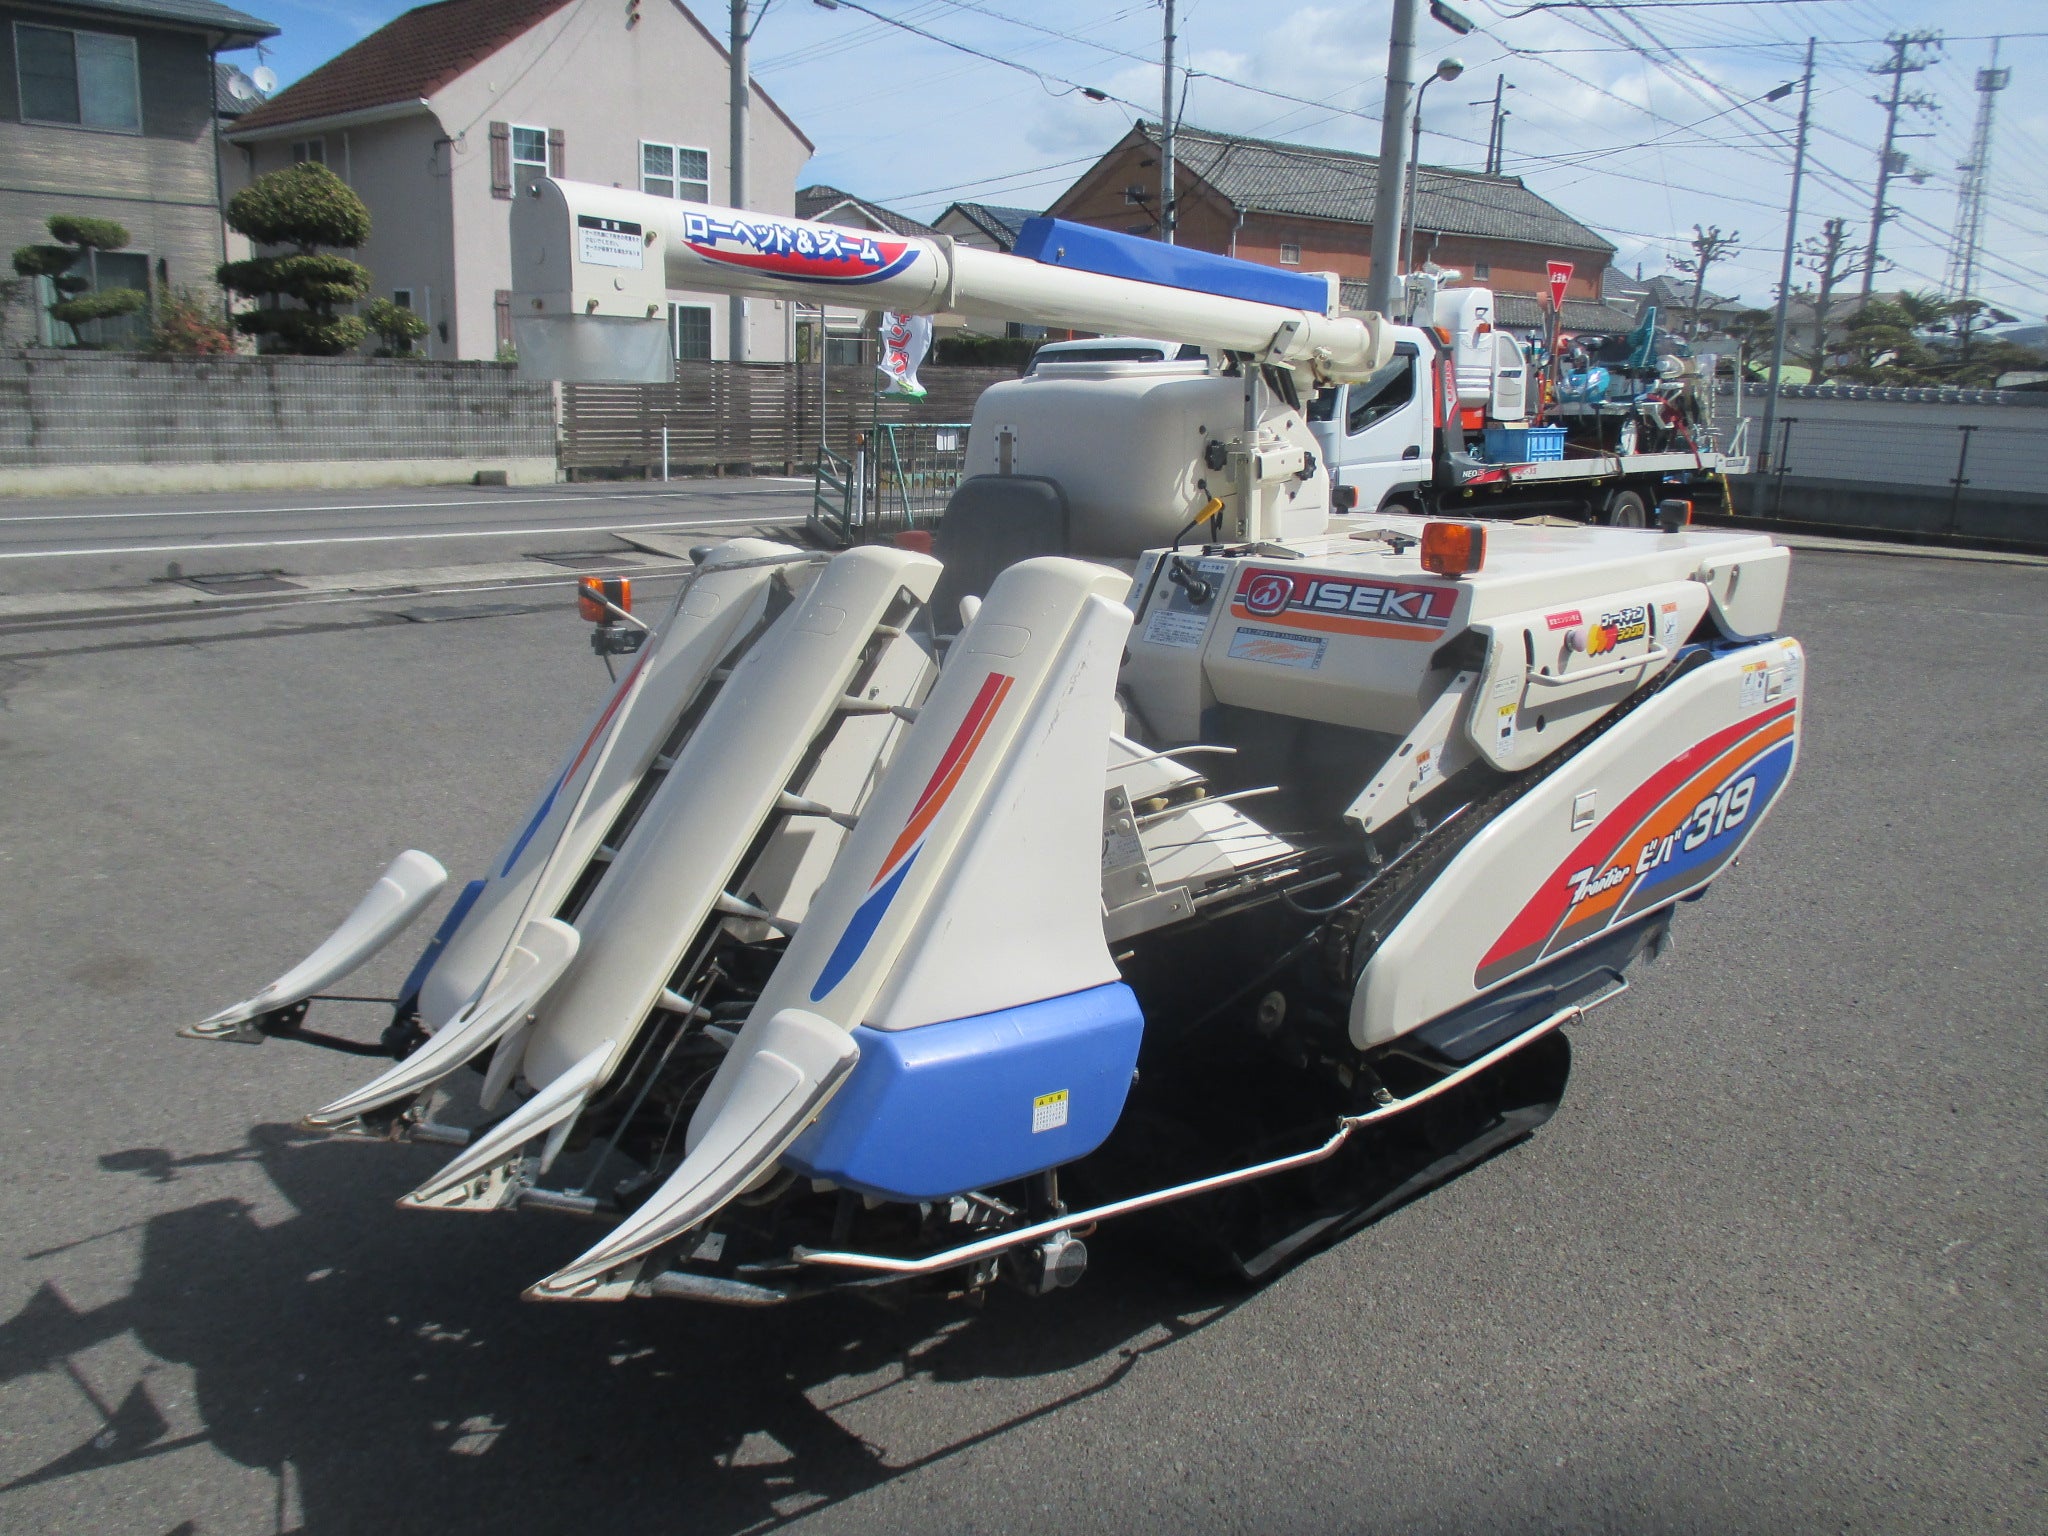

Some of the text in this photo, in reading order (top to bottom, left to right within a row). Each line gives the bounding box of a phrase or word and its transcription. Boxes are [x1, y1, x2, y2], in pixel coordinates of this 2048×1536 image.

[683, 213, 881, 263] ローヘッド&ズーム
[1551, 272, 1568, 284] 止まれ
[1303, 581, 1434, 620] ISEKI
[1684, 776, 1756, 852] 319
